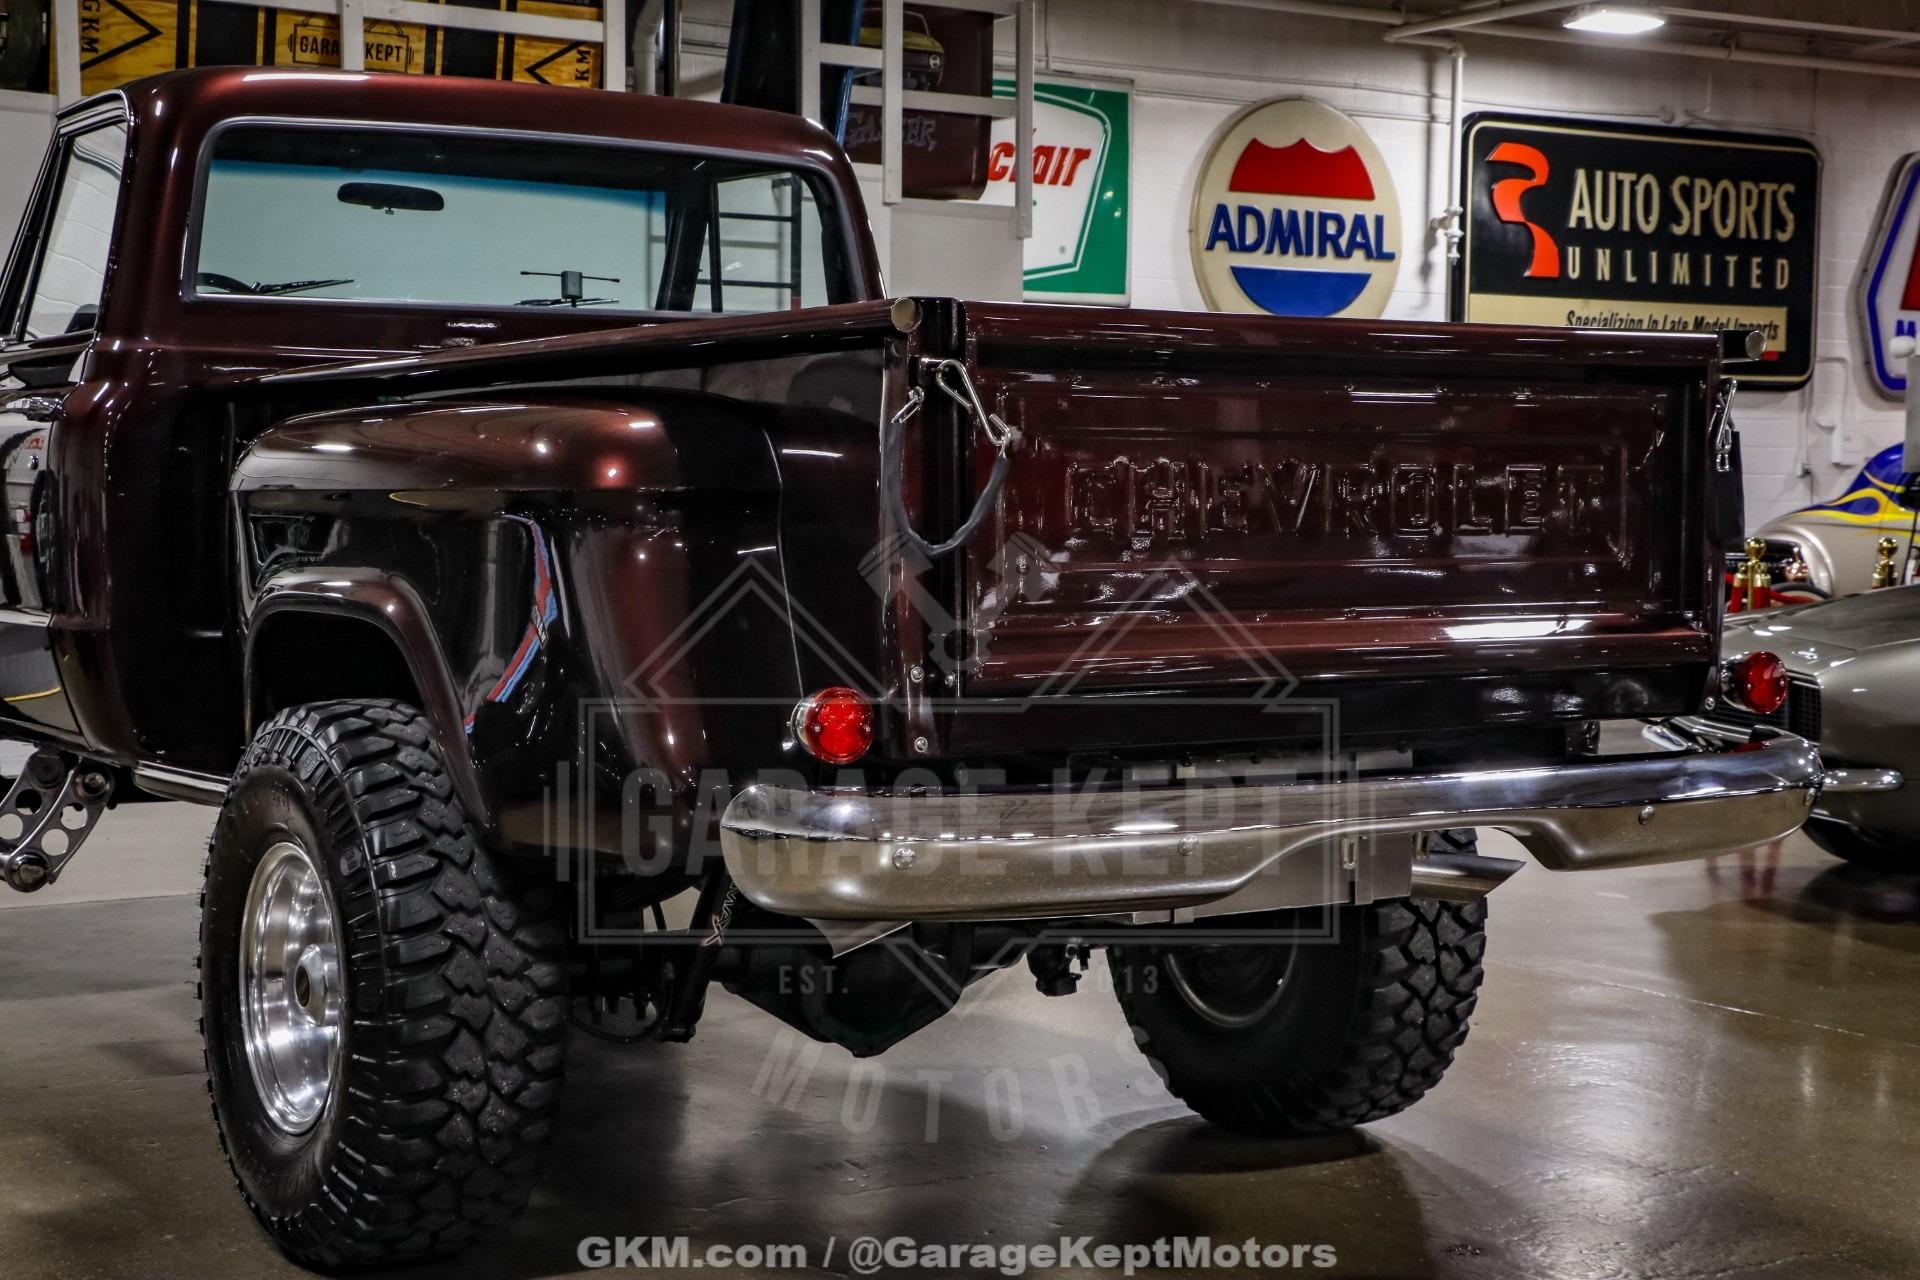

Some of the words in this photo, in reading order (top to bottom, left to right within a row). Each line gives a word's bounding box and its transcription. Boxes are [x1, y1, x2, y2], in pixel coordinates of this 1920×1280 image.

[82, 0, 101, 54] GKM
[300, 35, 340, 56] GARA
[365, 42, 402, 62] KEPT
[575, 48, 591, 81] KM
[1205, 203, 1396, 261] ADMIRAL
[1568, 168, 1660, 234] AUTO
[1670, 175, 1795, 242] SPORTS
[1567, 246, 1790, 290] UNLIMITED
[1064, 457, 1605, 541] CHEVROLET
